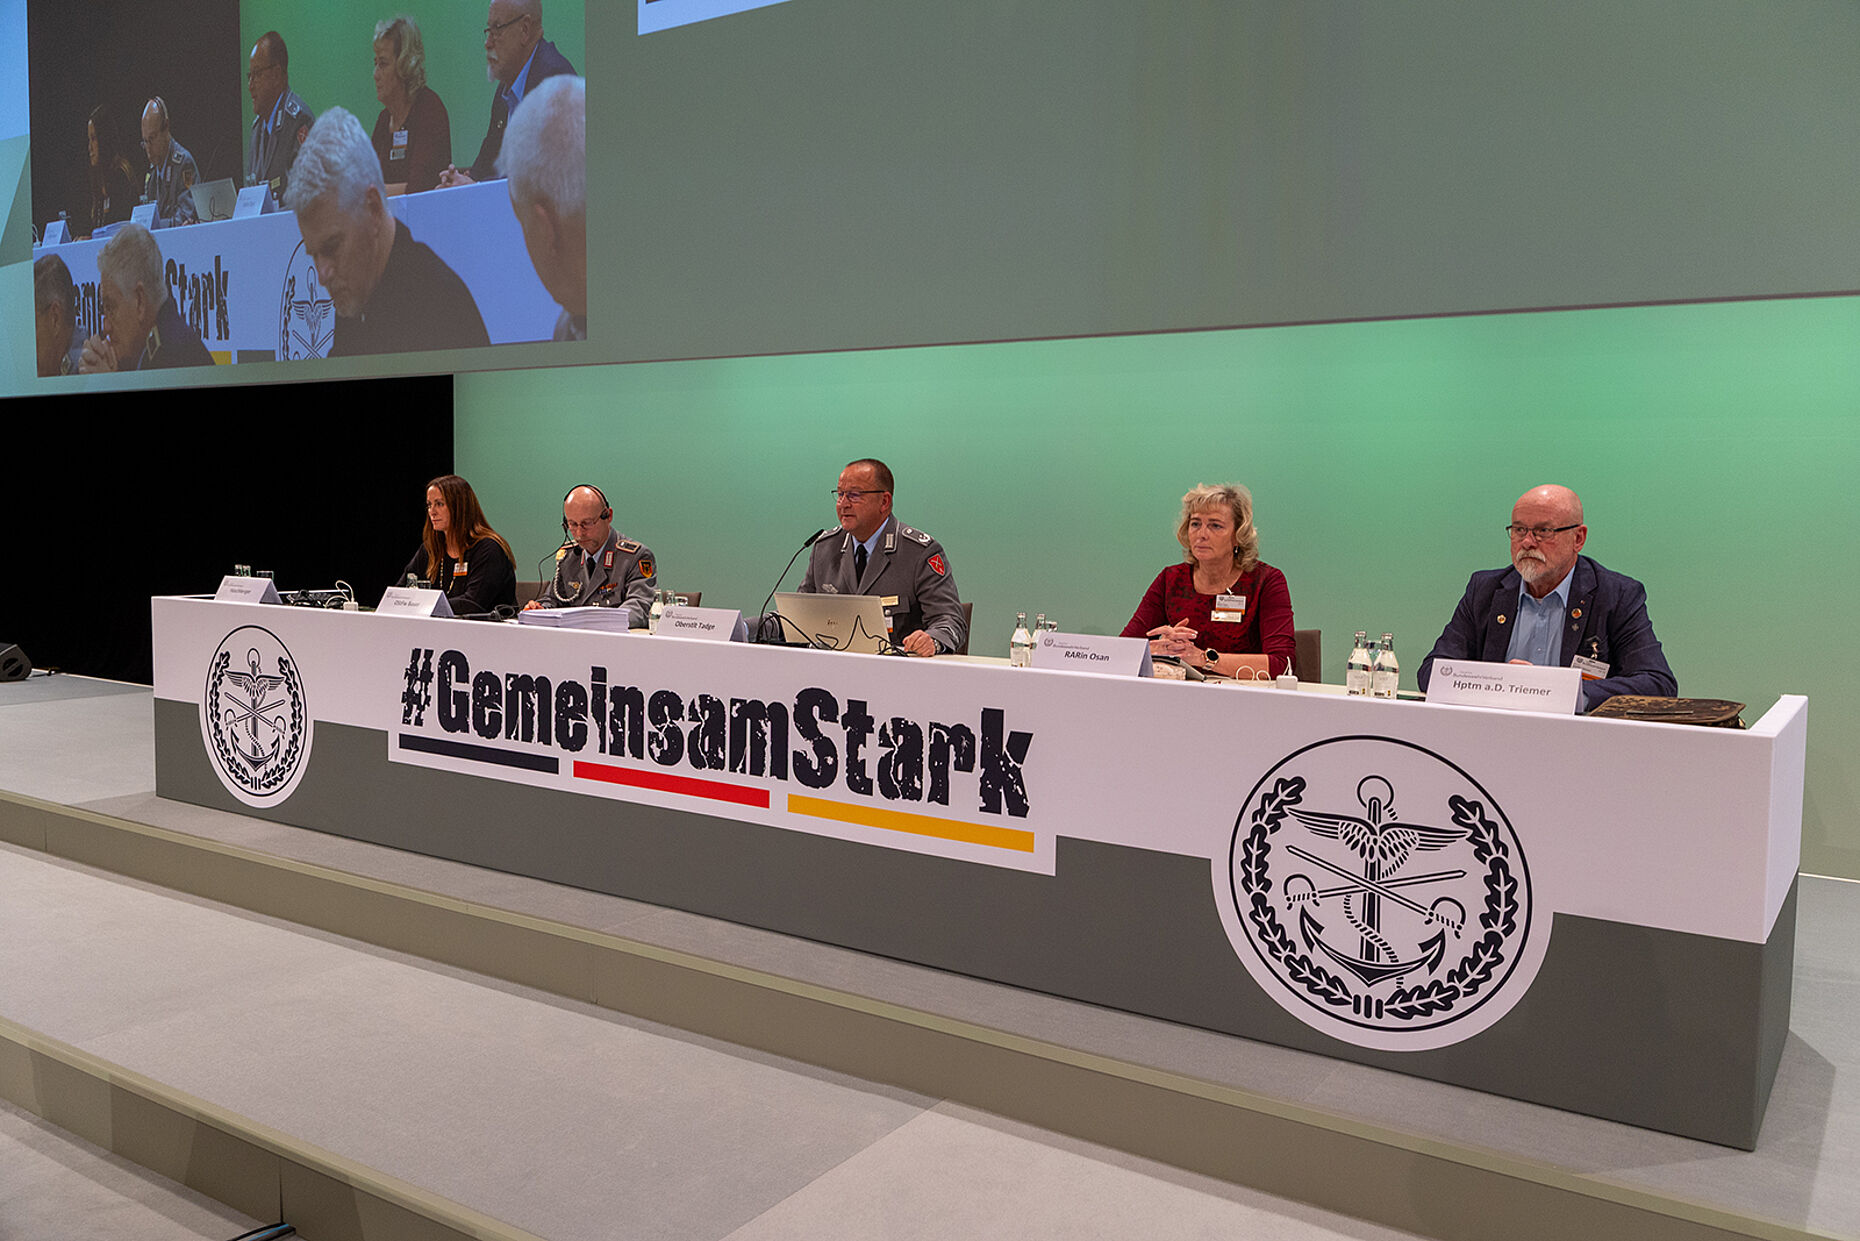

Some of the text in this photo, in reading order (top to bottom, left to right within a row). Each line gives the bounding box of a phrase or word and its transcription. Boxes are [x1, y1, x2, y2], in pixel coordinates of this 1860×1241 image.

[698, 621, 715, 631] Tadge
[1064, 650, 1110, 661] RARin Osan
[1452, 680, 1552, 696] Hptm a.D. Triemer
[401, 648, 1034, 818] #GemeinsamStark
